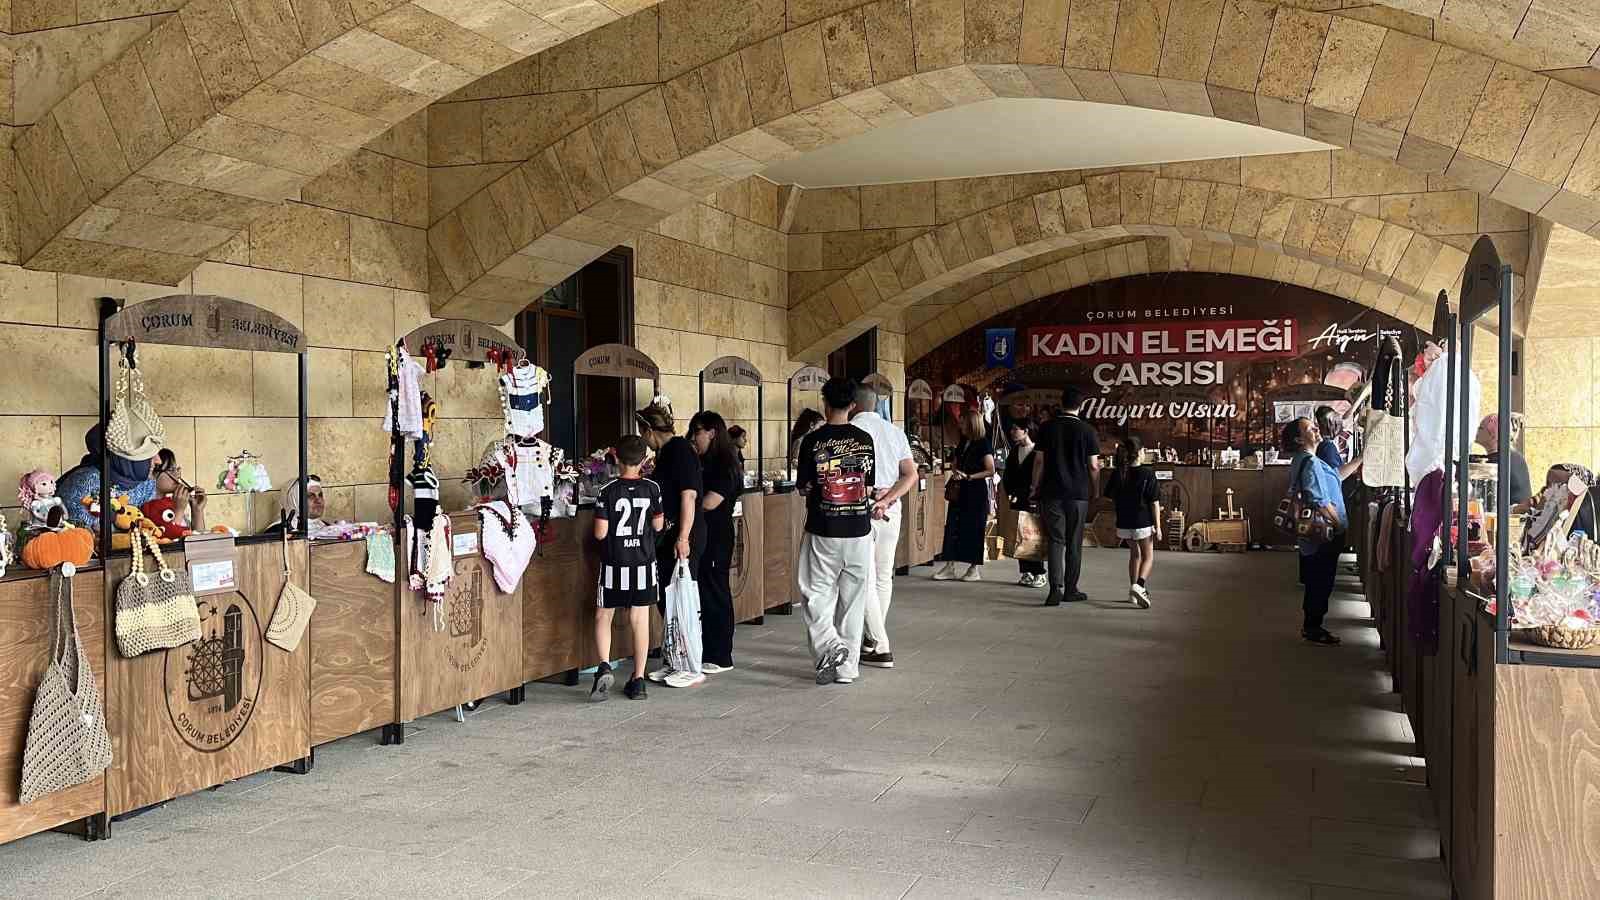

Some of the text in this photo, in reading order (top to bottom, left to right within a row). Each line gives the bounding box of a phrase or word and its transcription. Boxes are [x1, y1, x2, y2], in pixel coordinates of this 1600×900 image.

[141, 312, 193, 332] ÇORUM
[1086, 304, 1234, 322] ÇORUM BELEDİYESİ
[1031, 319, 1293, 357] KADIN EL EMEĞİ
[1092, 360, 1225, 394] ÇARŞISI
[1168, 398, 1238, 420] Olsun
[615, 497, 651, 537] 27
